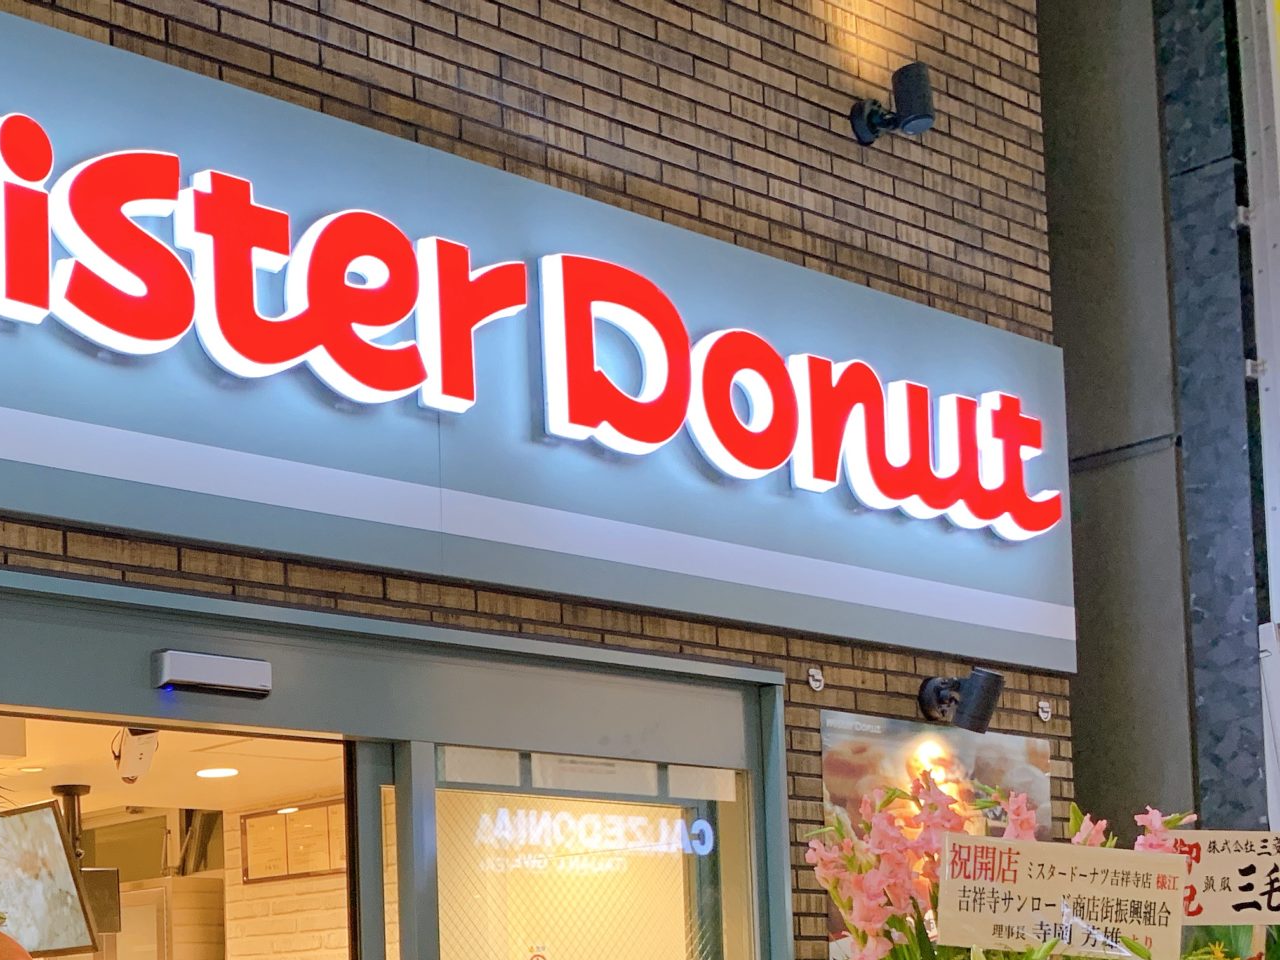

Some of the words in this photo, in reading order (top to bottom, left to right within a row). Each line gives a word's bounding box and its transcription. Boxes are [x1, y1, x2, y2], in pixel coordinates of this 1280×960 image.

[540, 250, 1063, 542] Donut
[949, 842, 1021, 884] 祝開店
